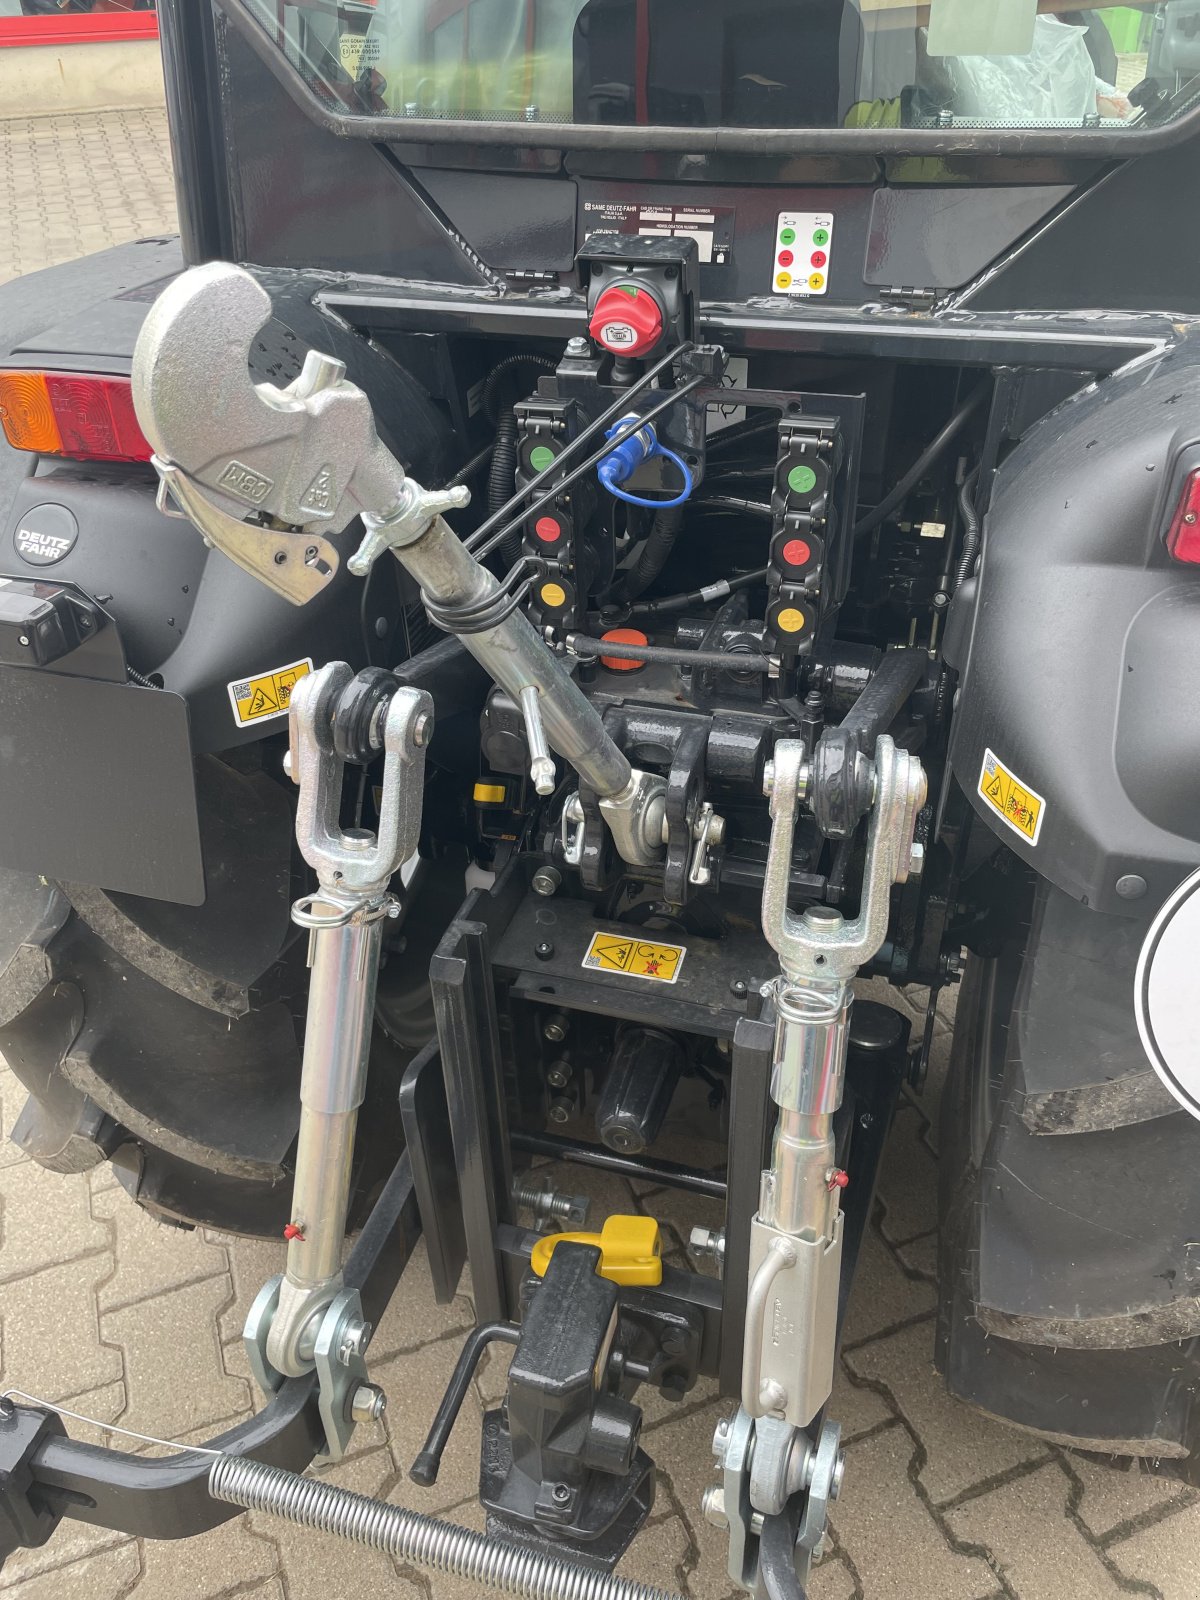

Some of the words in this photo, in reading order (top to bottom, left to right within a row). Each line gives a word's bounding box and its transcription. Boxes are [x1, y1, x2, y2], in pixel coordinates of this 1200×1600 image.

[224, 466, 268, 497] CBM
[18, 529, 70, 550] DEUTZ
[19, 540, 61, 559] FAHR
